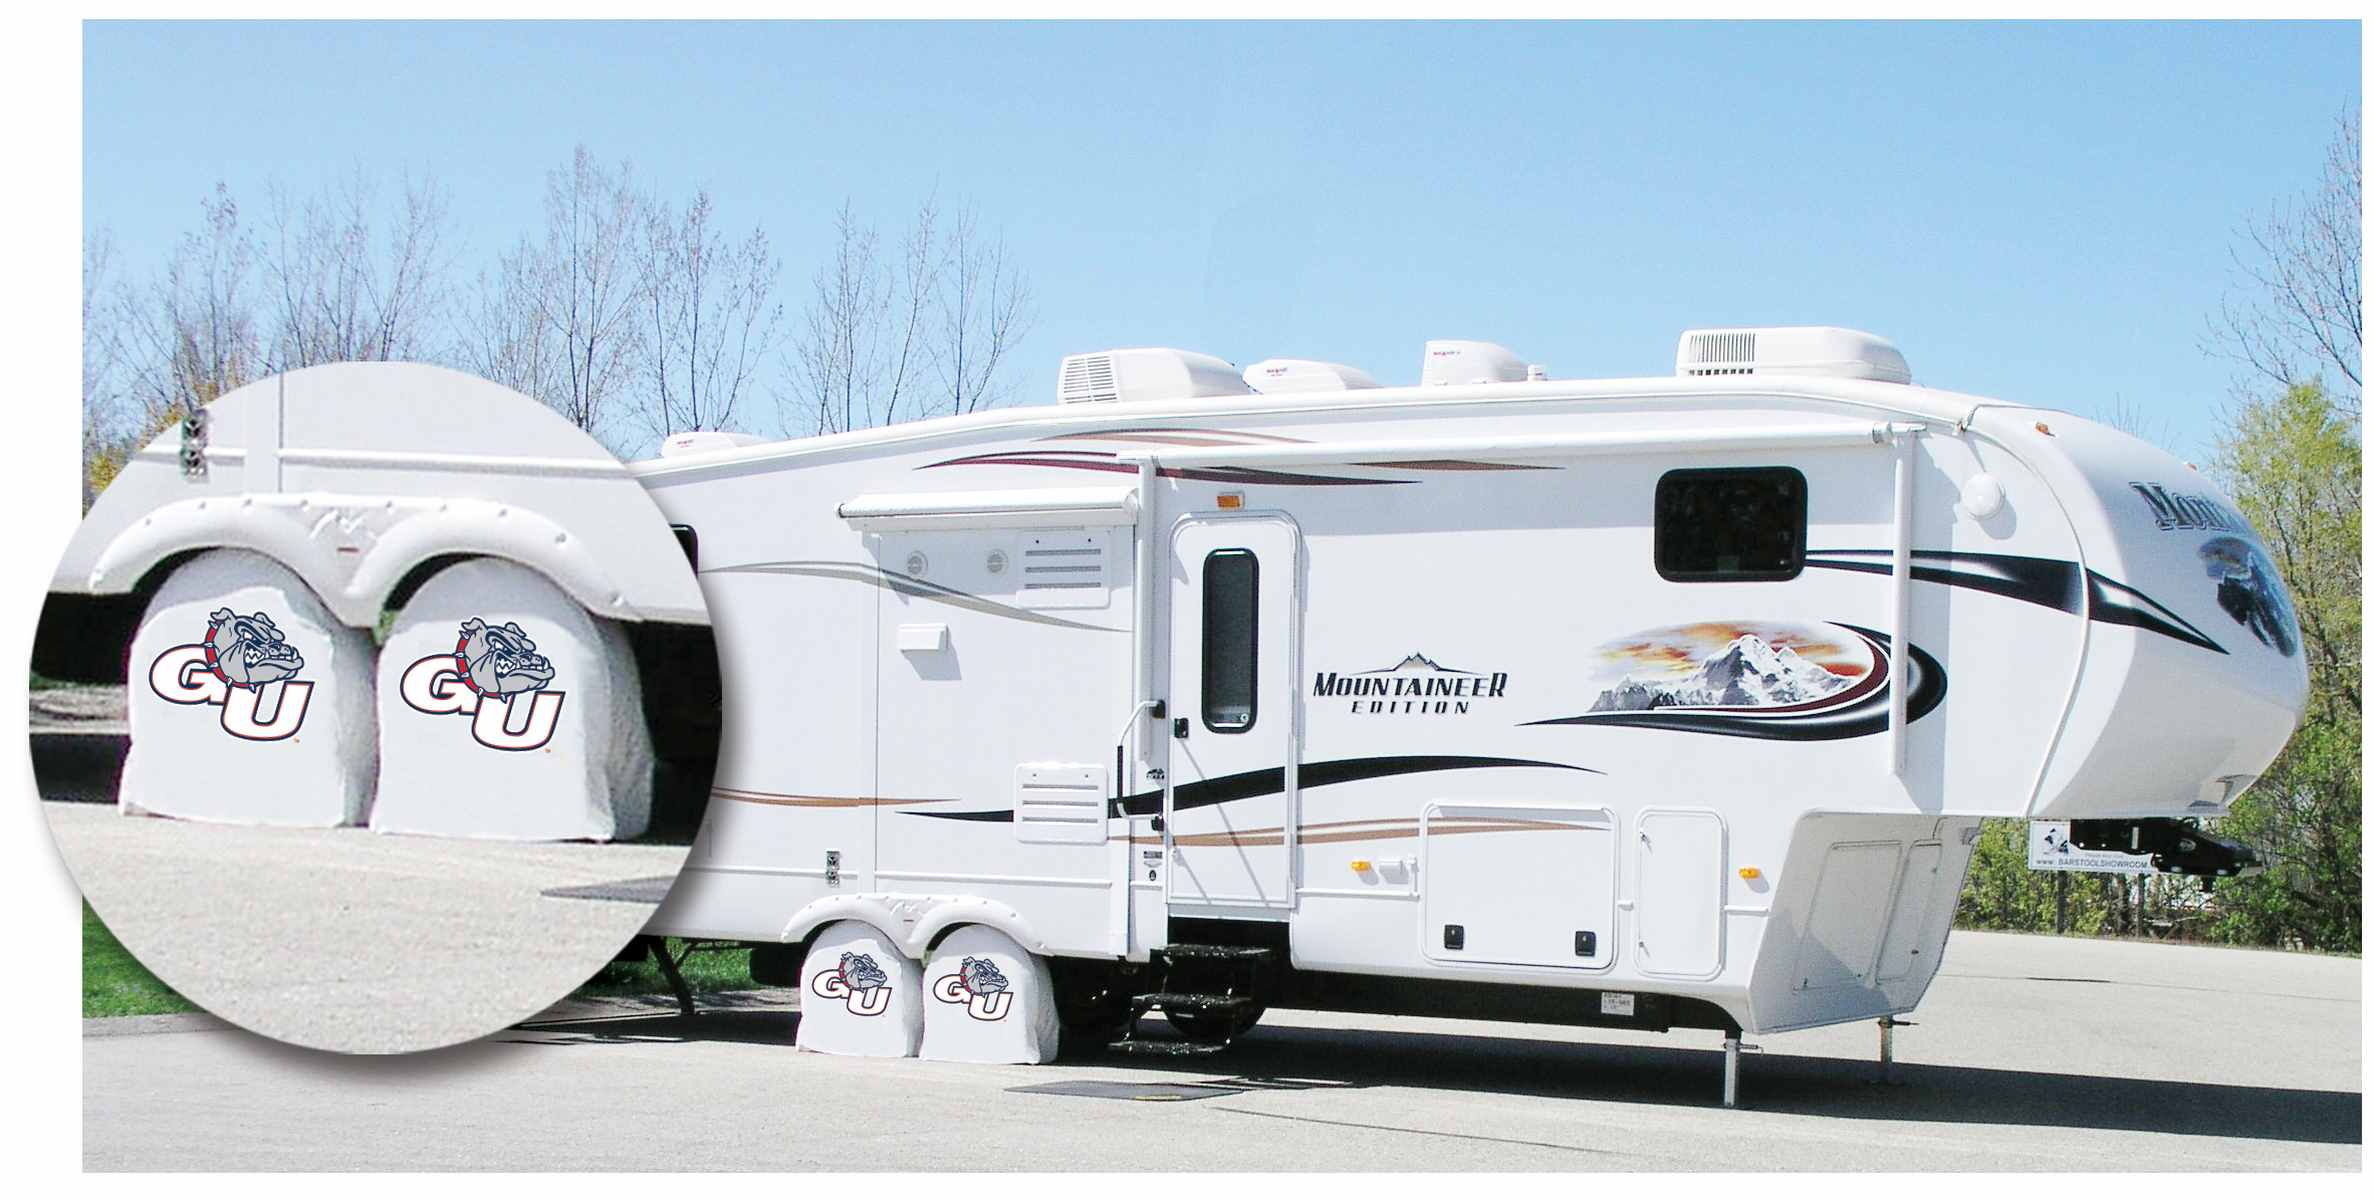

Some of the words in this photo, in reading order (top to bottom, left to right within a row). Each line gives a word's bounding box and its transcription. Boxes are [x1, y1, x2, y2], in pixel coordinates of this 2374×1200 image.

[149, 643, 316, 741] GU
[400, 653, 566, 752] GU
[1313, 671, 1508, 697] MOUNTAINEER
[1351, 701, 1470, 714] EDITION
[812, 969, 892, 1016] GU
[933, 974, 1014, 1022] GU
